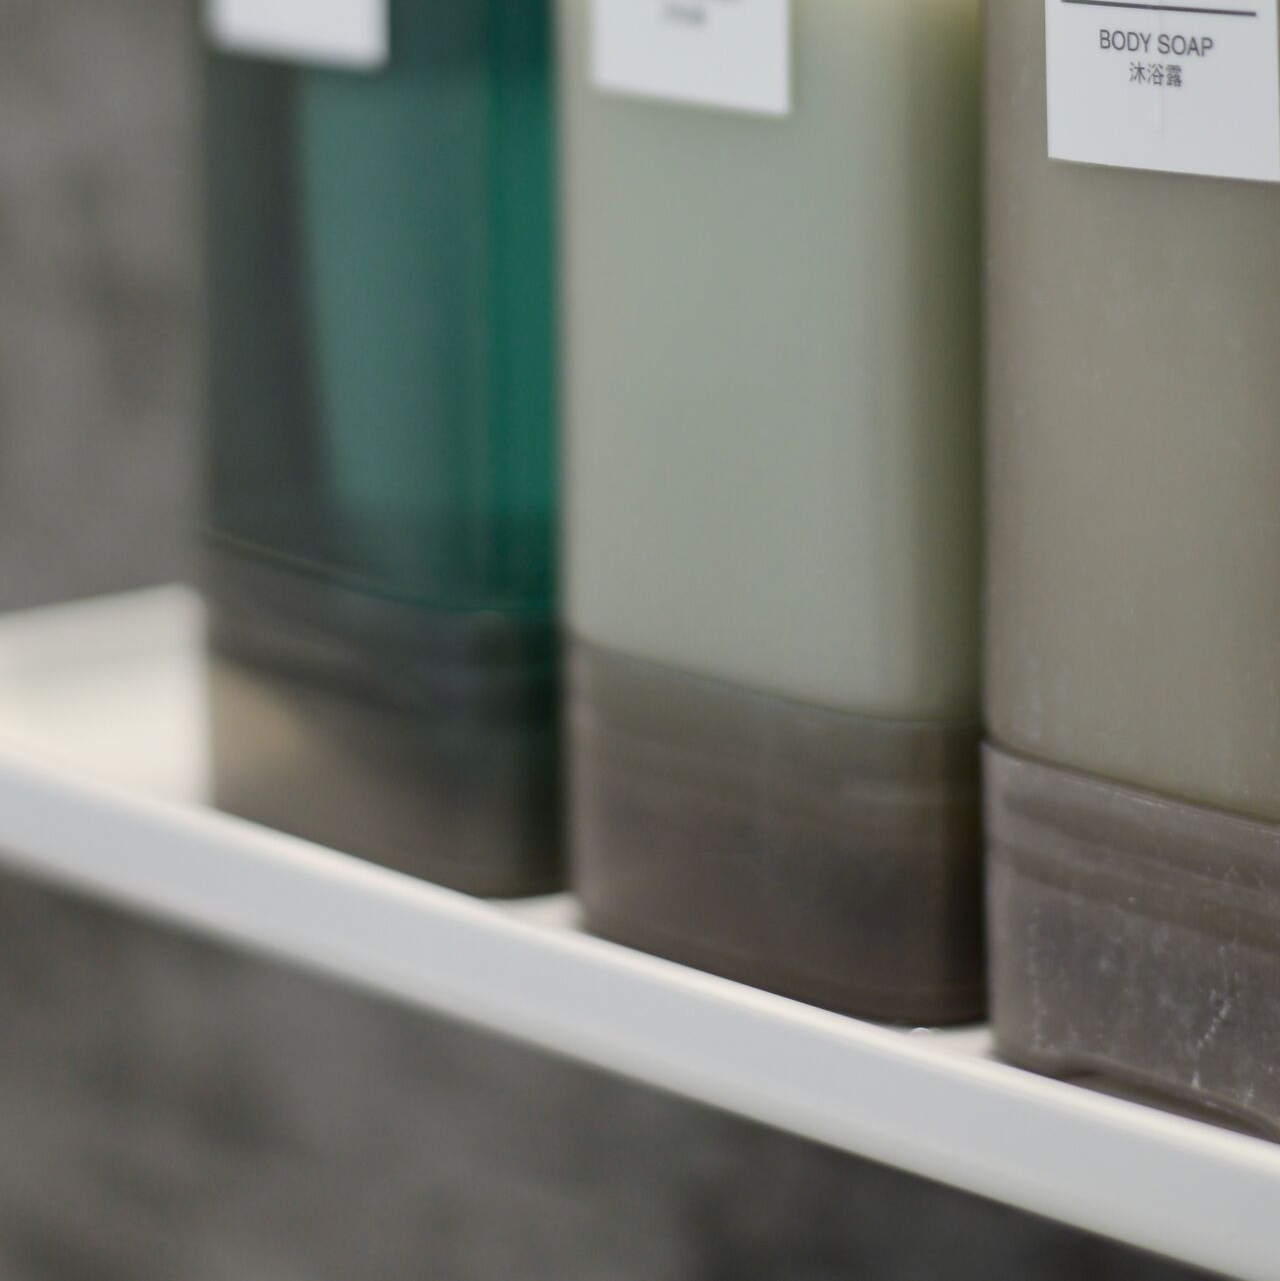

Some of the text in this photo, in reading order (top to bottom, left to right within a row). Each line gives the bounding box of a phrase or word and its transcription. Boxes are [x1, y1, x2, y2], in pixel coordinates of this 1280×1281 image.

[1099, 29, 1214, 57] BODY SOAP
[1128, 61, 1183, 88] 沐浴露
